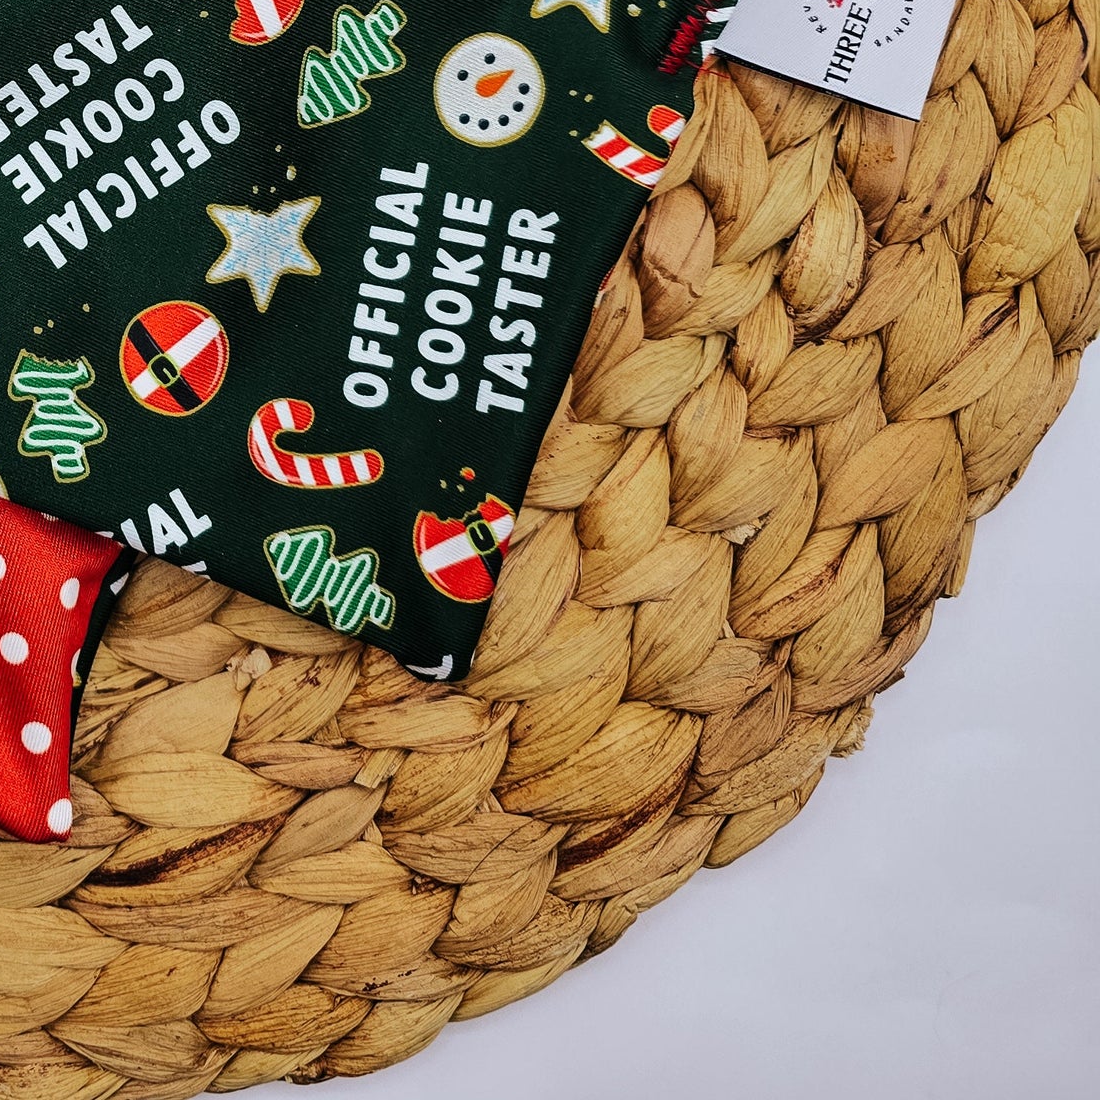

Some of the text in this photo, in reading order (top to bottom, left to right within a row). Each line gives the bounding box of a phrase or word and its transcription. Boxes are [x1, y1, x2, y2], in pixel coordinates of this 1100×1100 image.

[0, 58, 185, 205] COOKIE
[822, 2, 873, 84] THREE
[22, 99, 241, 270] OFFICIAL
[342, 162, 430, 408] OFFICIAL
[410, 192, 493, 401] COOKIE
[475, 208, 560, 414] TASTER
